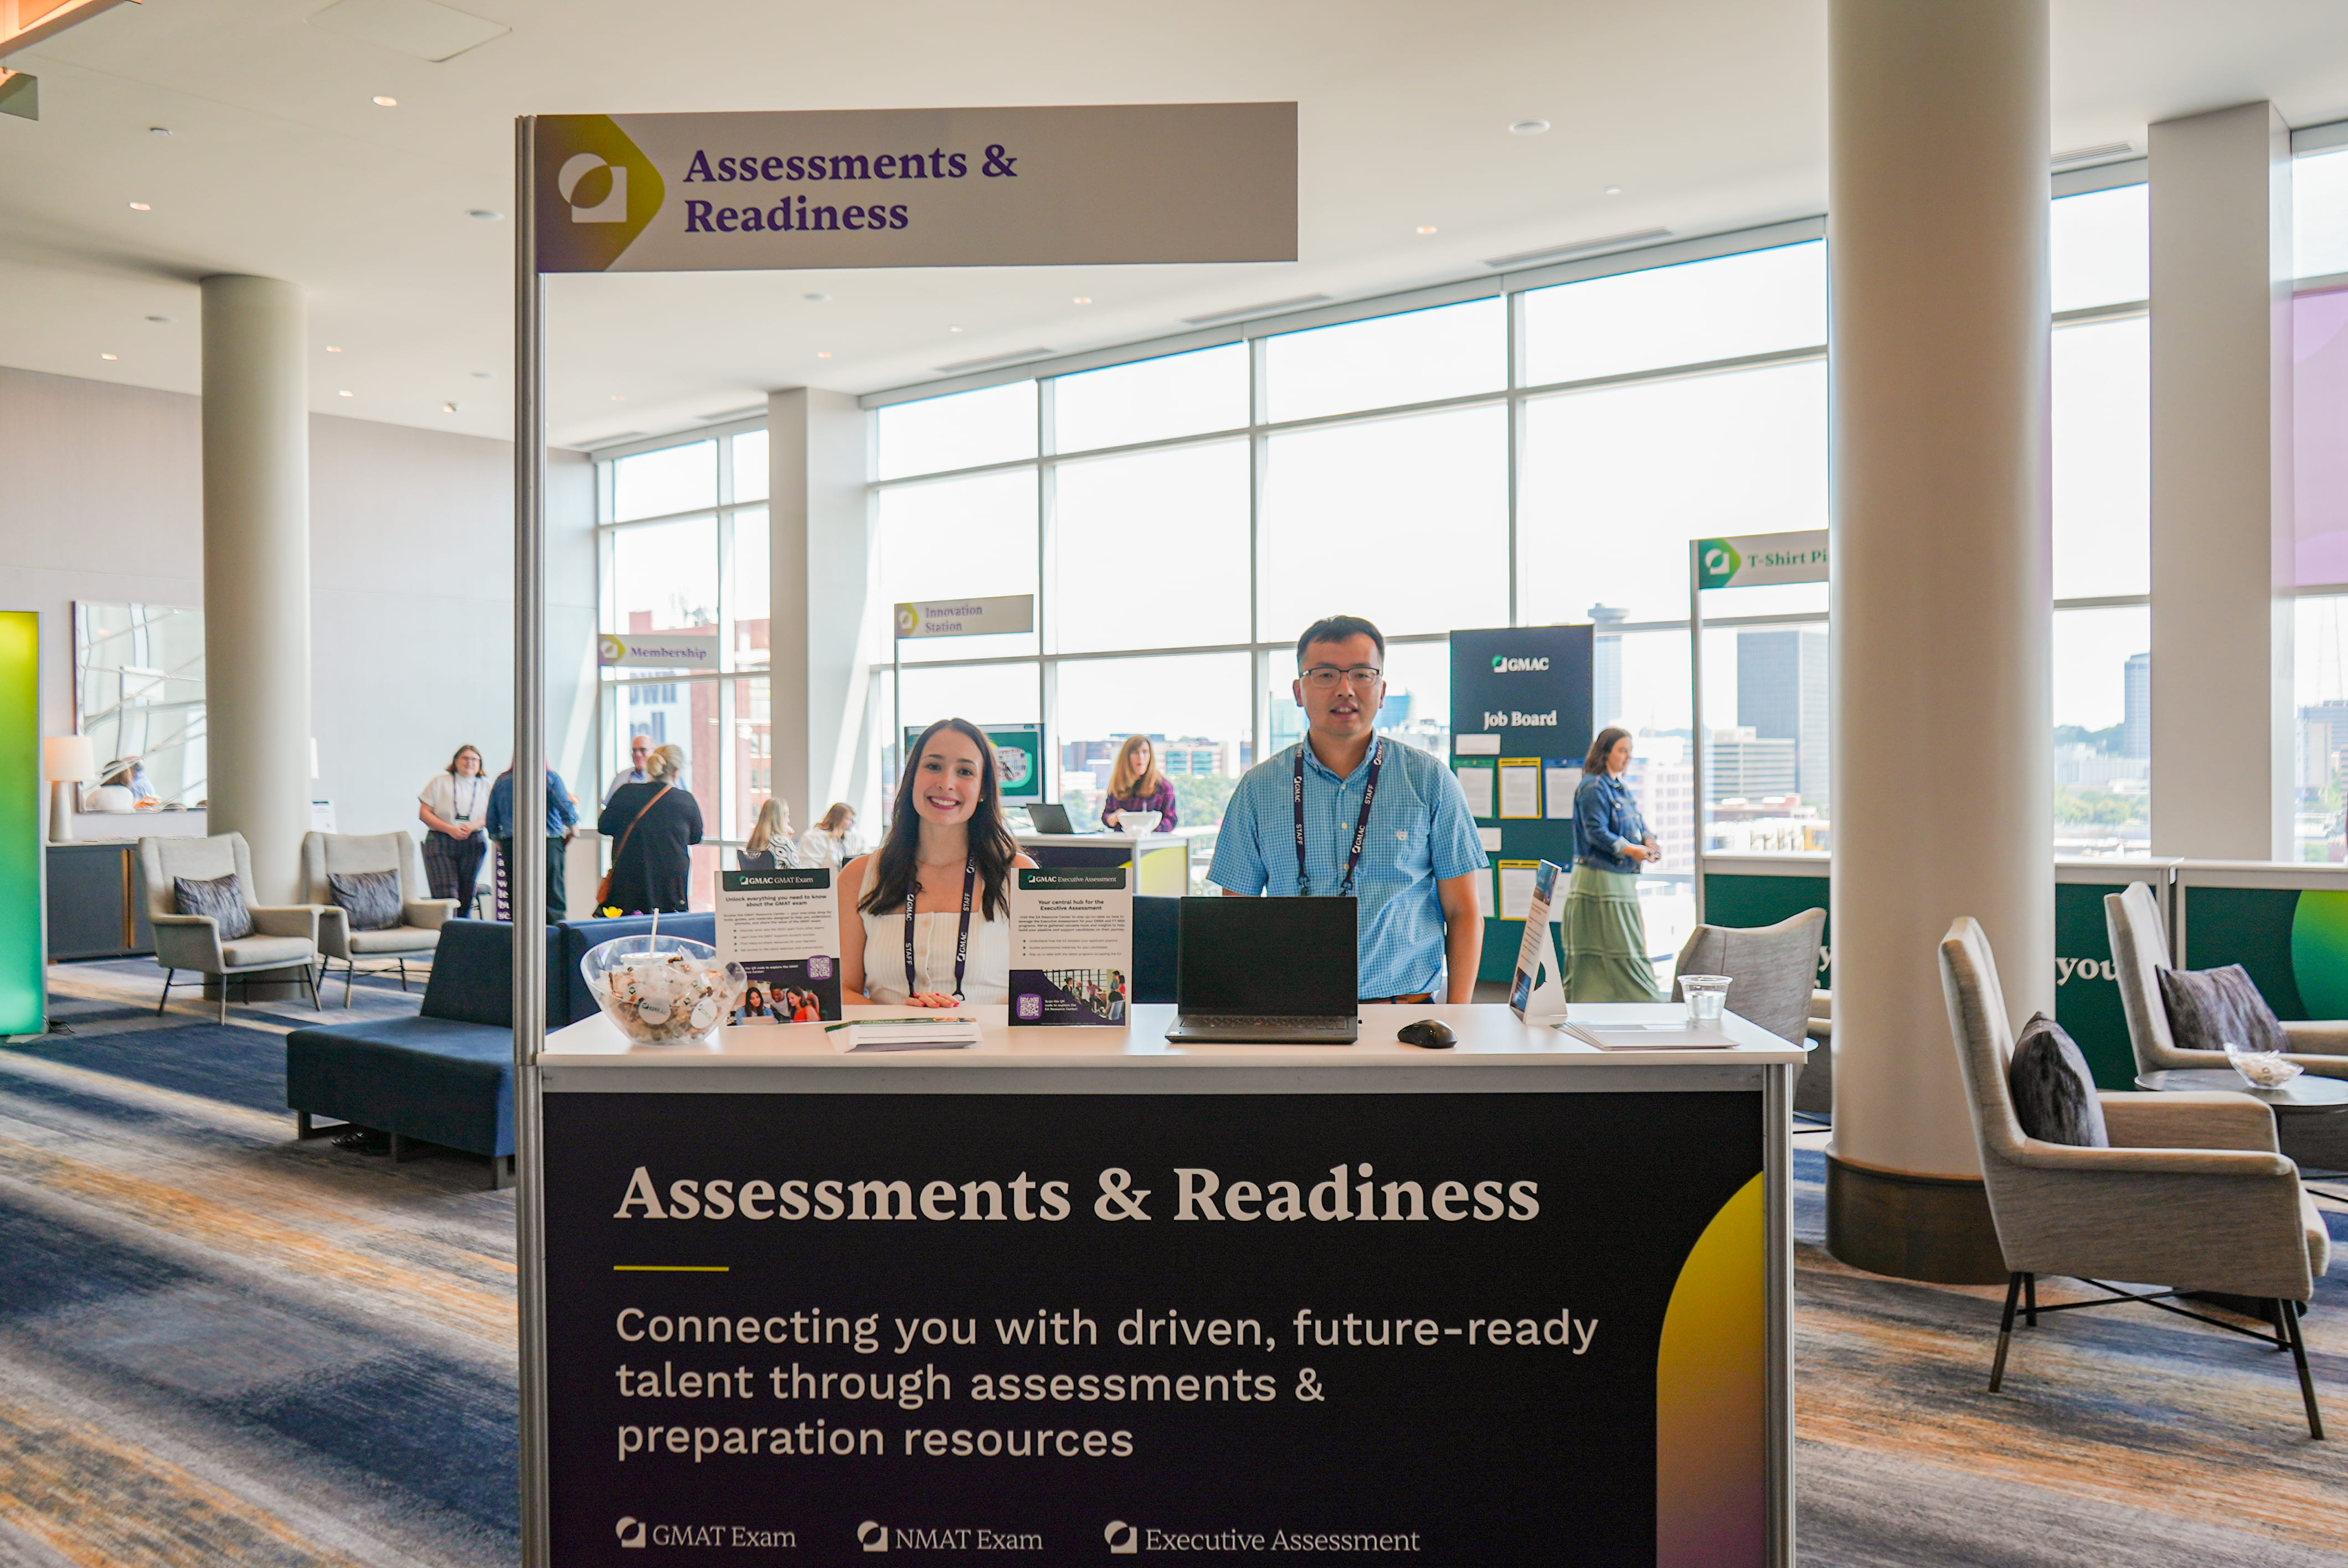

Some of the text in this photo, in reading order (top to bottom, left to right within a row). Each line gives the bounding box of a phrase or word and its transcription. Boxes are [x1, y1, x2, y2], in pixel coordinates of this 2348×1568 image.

[682, 143, 1018, 183] Assessments &
[684, 194, 909, 233] Readiness
[1748, 550, 1806, 568] T-Shirt
[925, 604, 983, 618] Innovation
[925, 621, 962, 633] Station
[630, 647, 707, 661] Membership
[1507, 657, 1549, 672] GMAC
[1483, 709, 1558, 731] Job Board
[1364, 784, 1374, 805] STAFF
[1295, 823, 1304, 845] STAFF
[1355, 824, 1366, 847] GMAC
[962, 893, 971, 912] STAFF
[905, 942, 913, 966] STAFF
[959, 931, 968, 954] GMAC
[612, 1162, 1540, 1222] Assessments & Readiness
[616, 1307, 1599, 1355] Connecting you with driven, future-ready
[615, 1360, 1326, 1410] talent through assessments &
[618, 1418, 1134, 1463] preparation resources
[652, 1524, 797, 1548] GMAT Exam
[895, 1528, 1043, 1550] NMAT Exam
[1145, 1528, 1421, 1552] Executive Assessment
